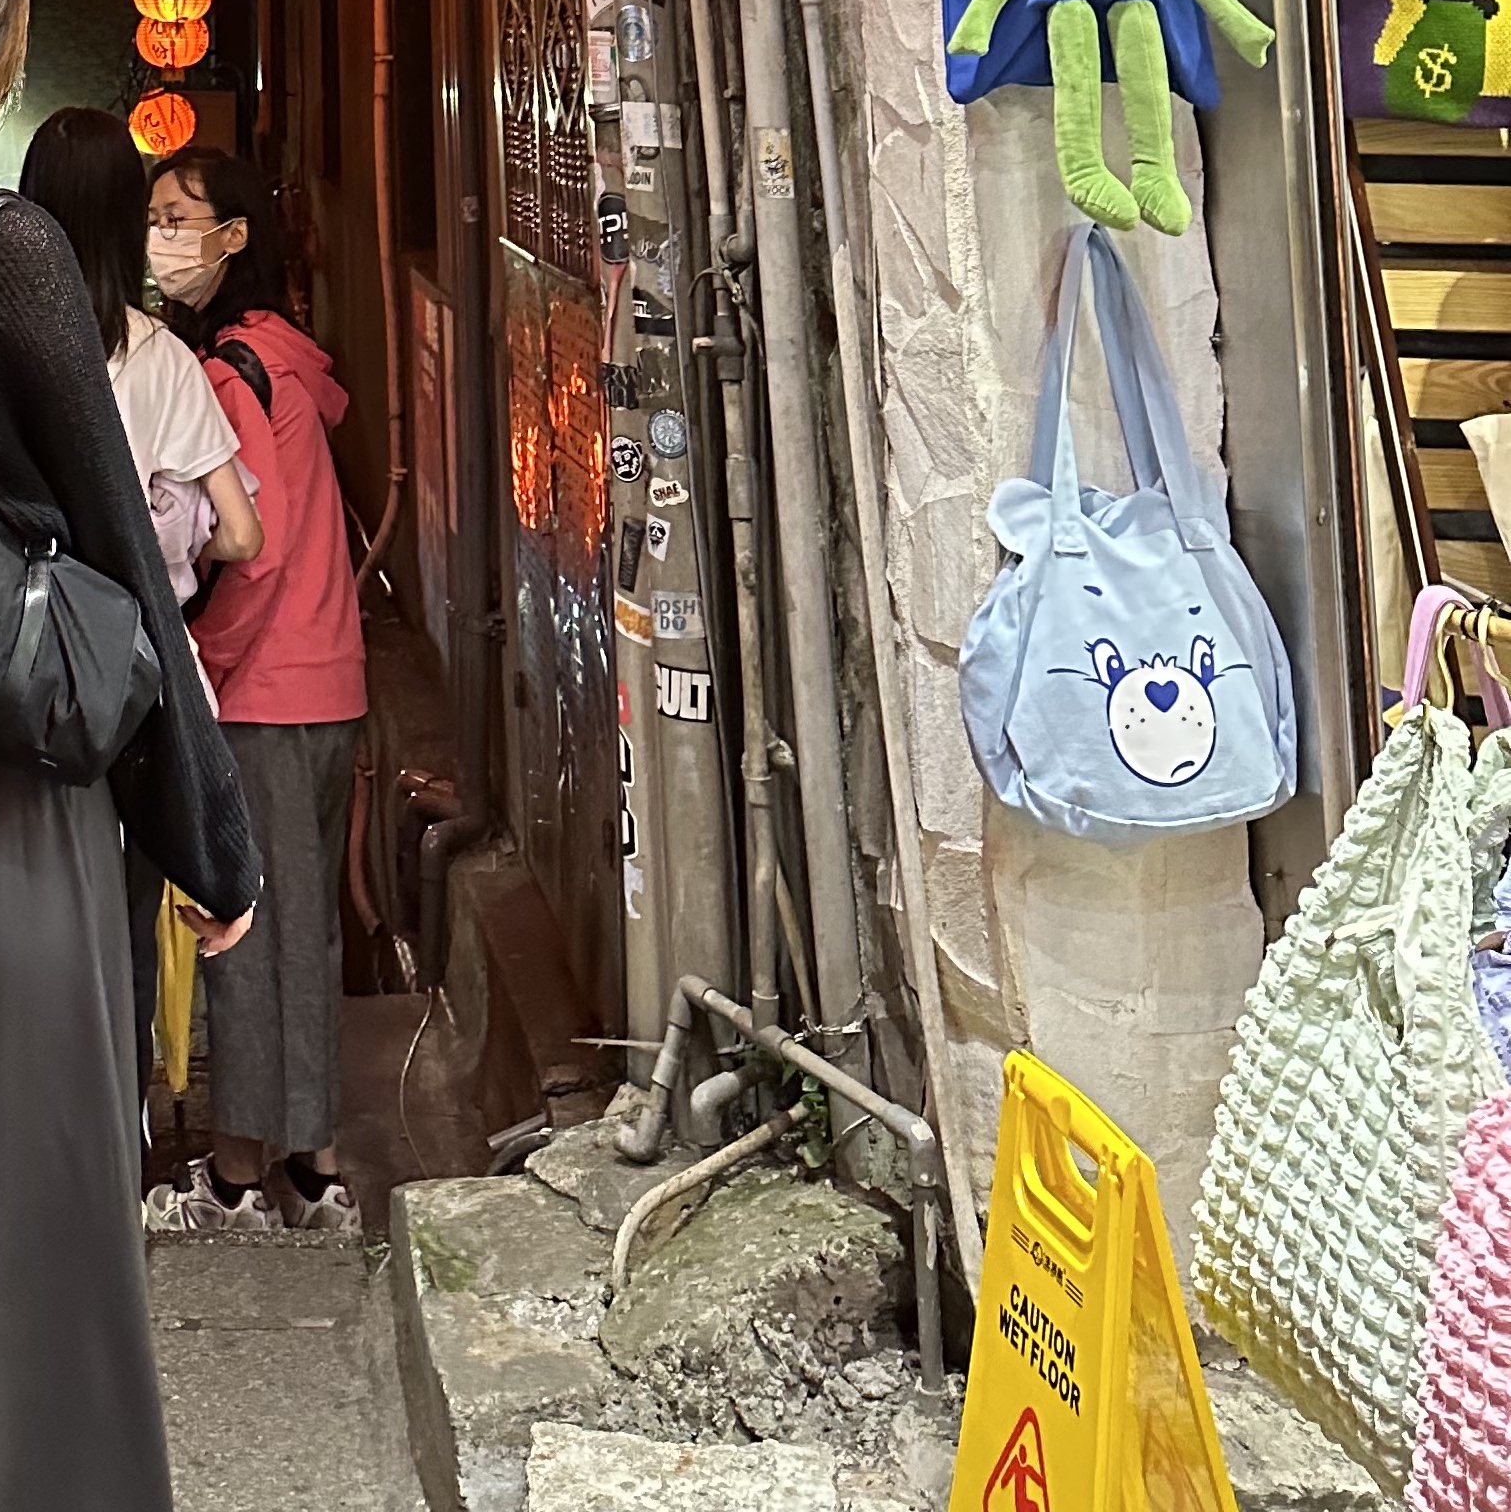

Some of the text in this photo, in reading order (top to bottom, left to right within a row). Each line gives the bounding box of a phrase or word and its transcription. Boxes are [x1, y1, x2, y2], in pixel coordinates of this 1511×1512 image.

[999, 1304, 1029, 1357] WET
[1029, 1337, 1081, 1418] FLOOR
[1010, 1283, 1076, 1373] CAUTION
